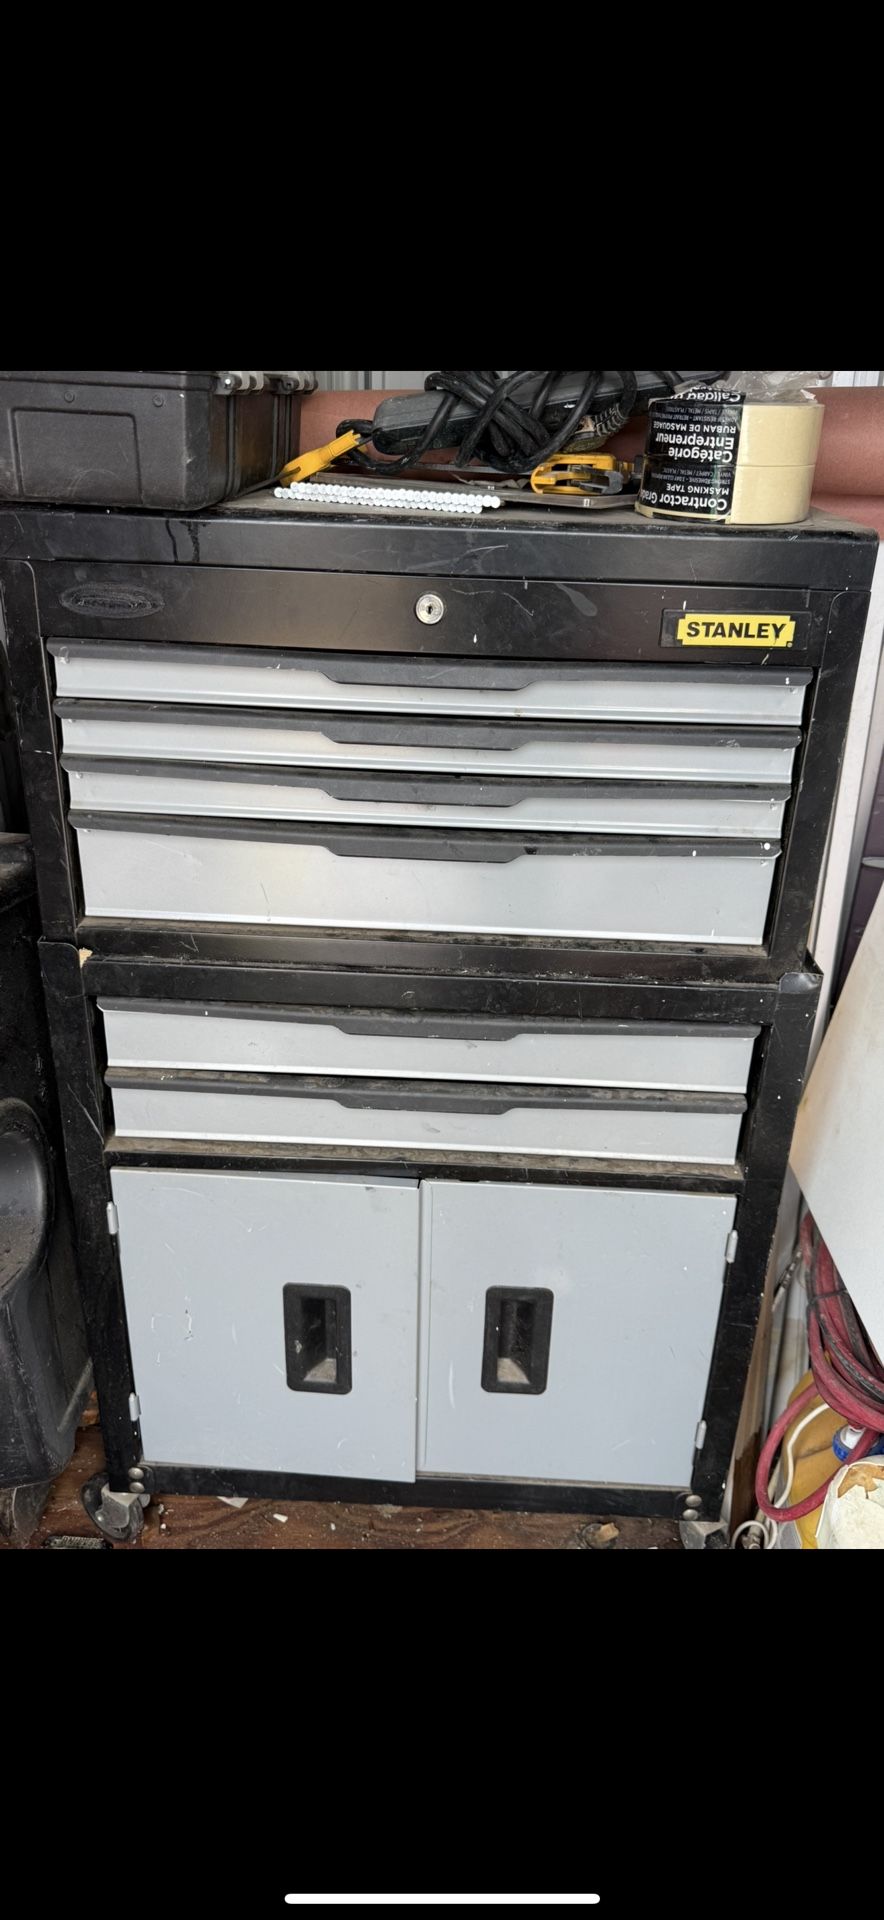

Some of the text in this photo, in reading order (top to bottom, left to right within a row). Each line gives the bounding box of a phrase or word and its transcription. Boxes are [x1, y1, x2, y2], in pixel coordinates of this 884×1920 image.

[653, 421, 736, 433] RUBAN DE MASQUAGE
[656, 433, 735, 450] Entrepreneur
[668, 447, 733, 463] Catégorie
[666, 483, 729, 495] MASKING TAPE
[659, 493, 728, 511] Contractor
[686, 621, 786, 639] STANLEY
